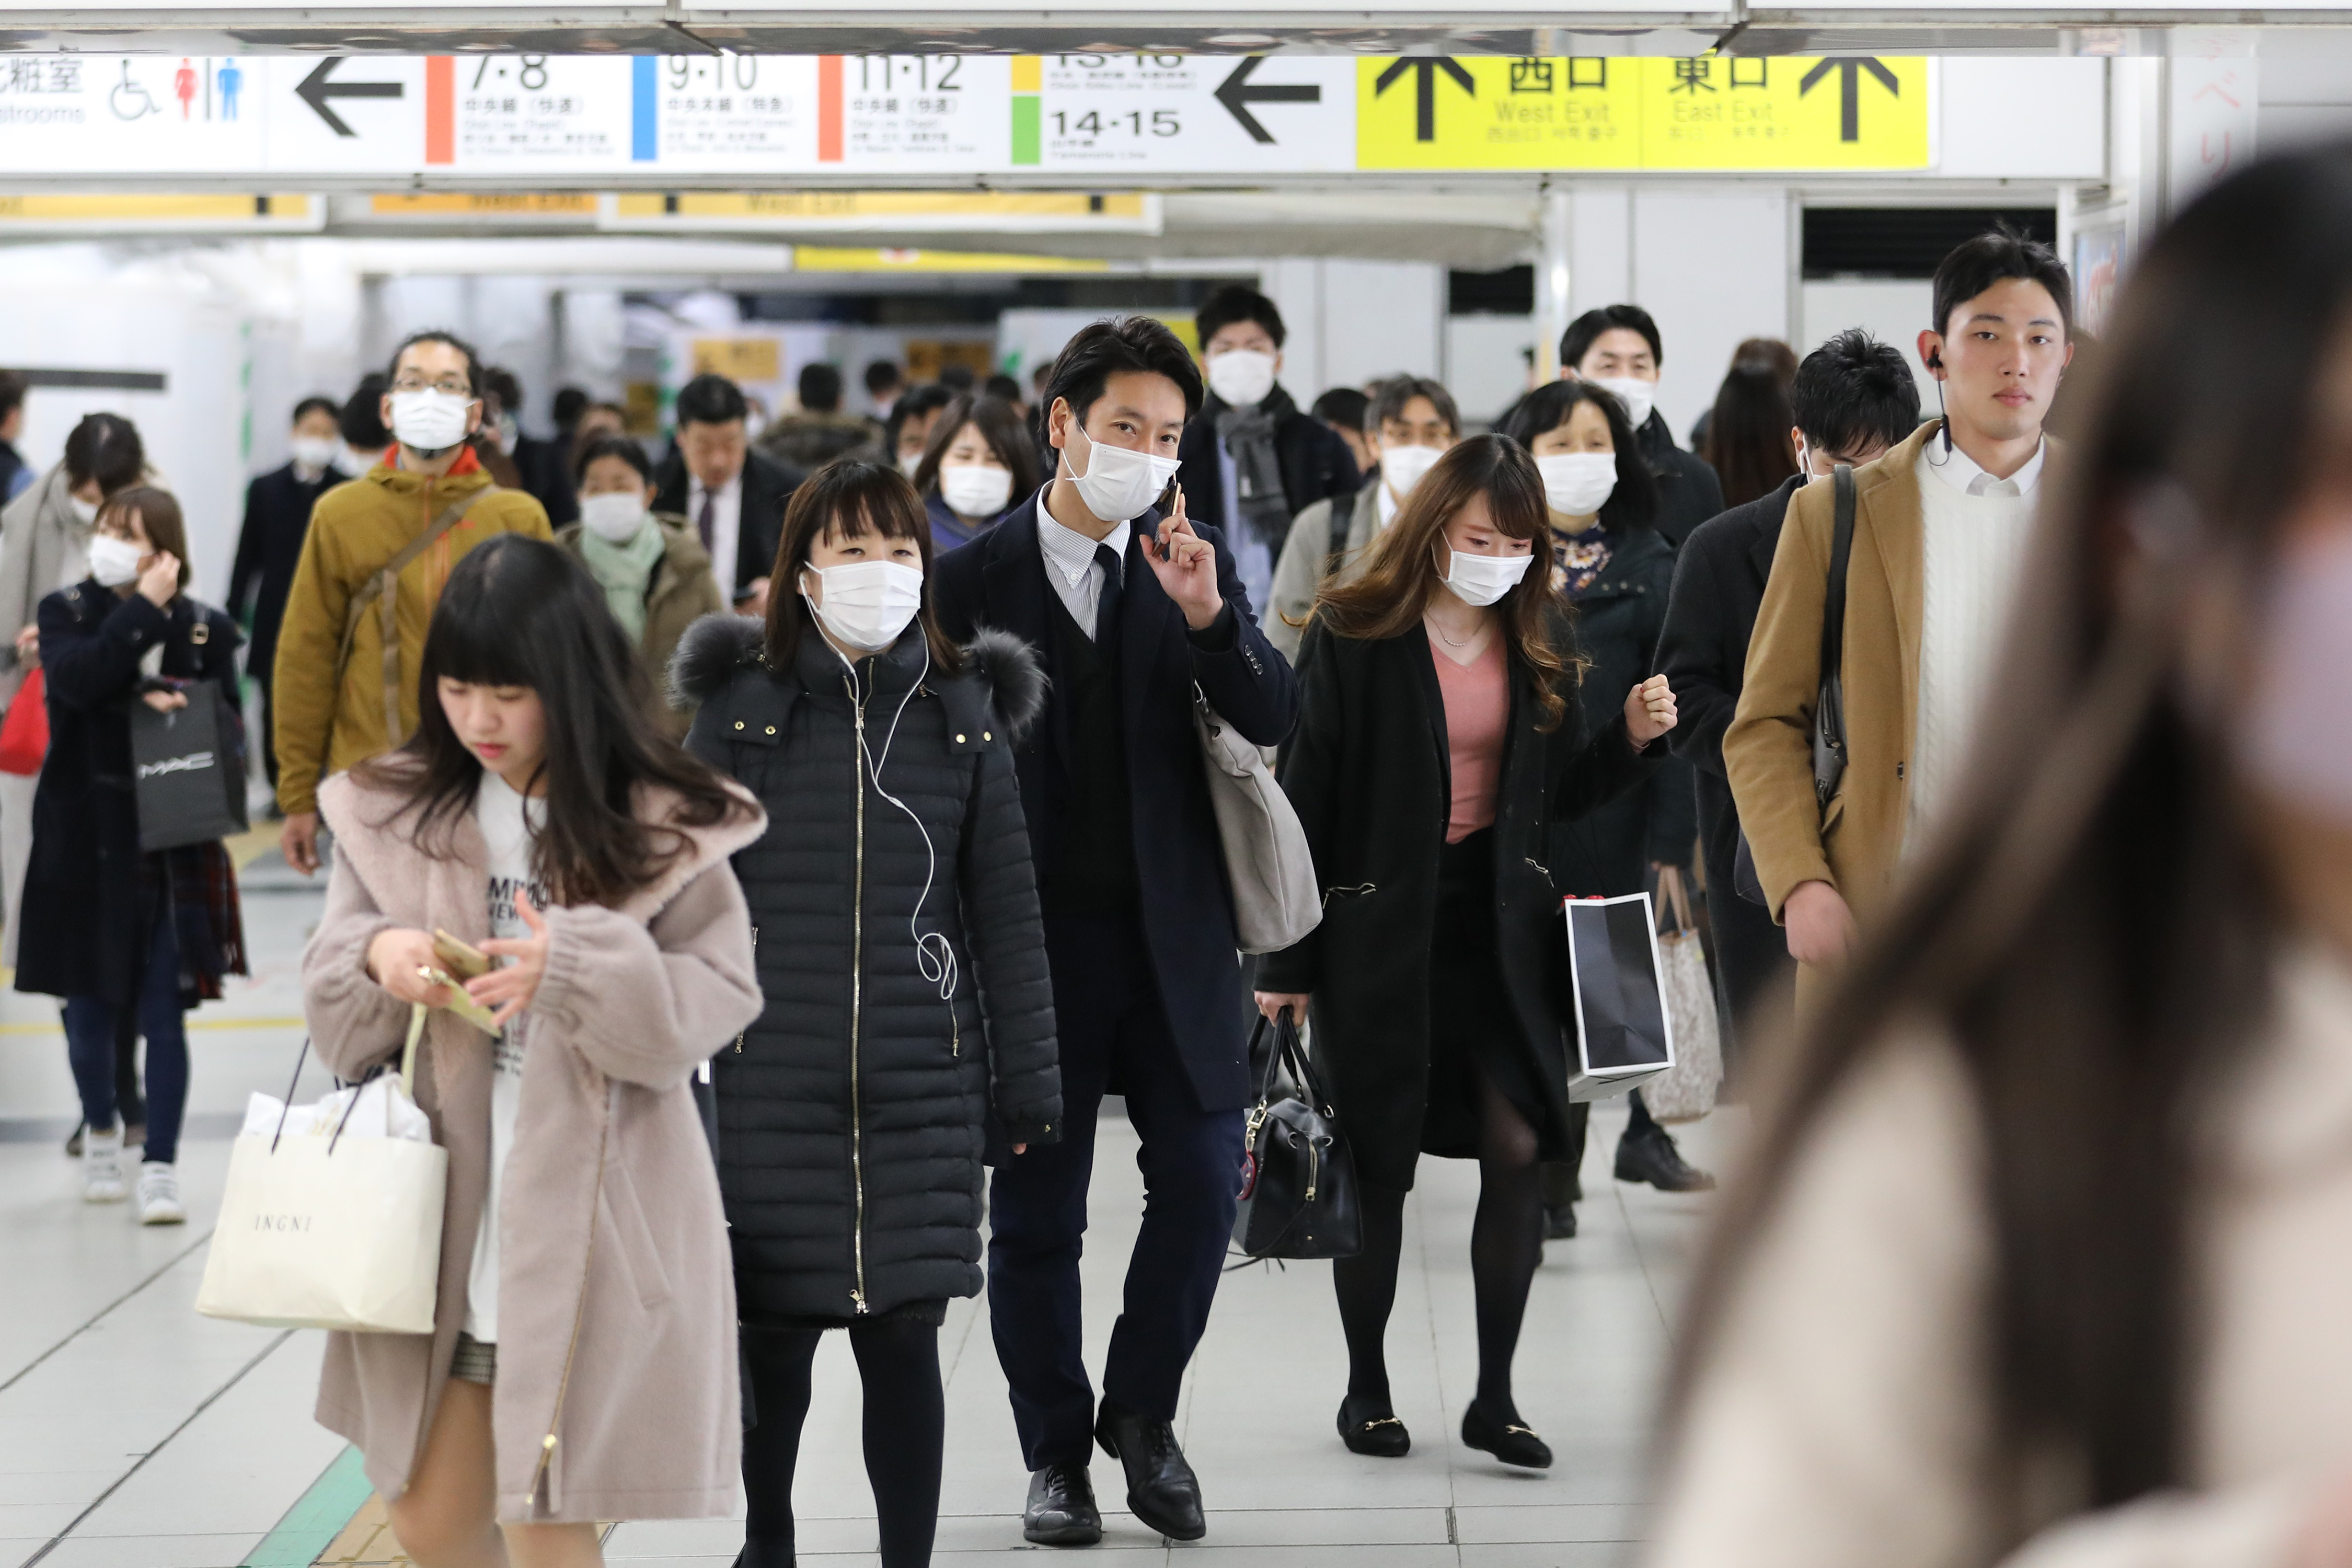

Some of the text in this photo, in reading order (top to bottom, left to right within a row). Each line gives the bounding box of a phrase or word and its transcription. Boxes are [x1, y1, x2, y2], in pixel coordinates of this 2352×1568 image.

[0, 57, 84, 93] 粧室
[1510, 57, 1606, 94] 西口
[1668, 57, 1767, 96] 東口
[1493, 100, 1610, 123] West Exit
[1673, 100, 1773, 122] East Exit
[2192, 57, 2240, 179] べり
[253, 1213, 313, 1231] INGNI
